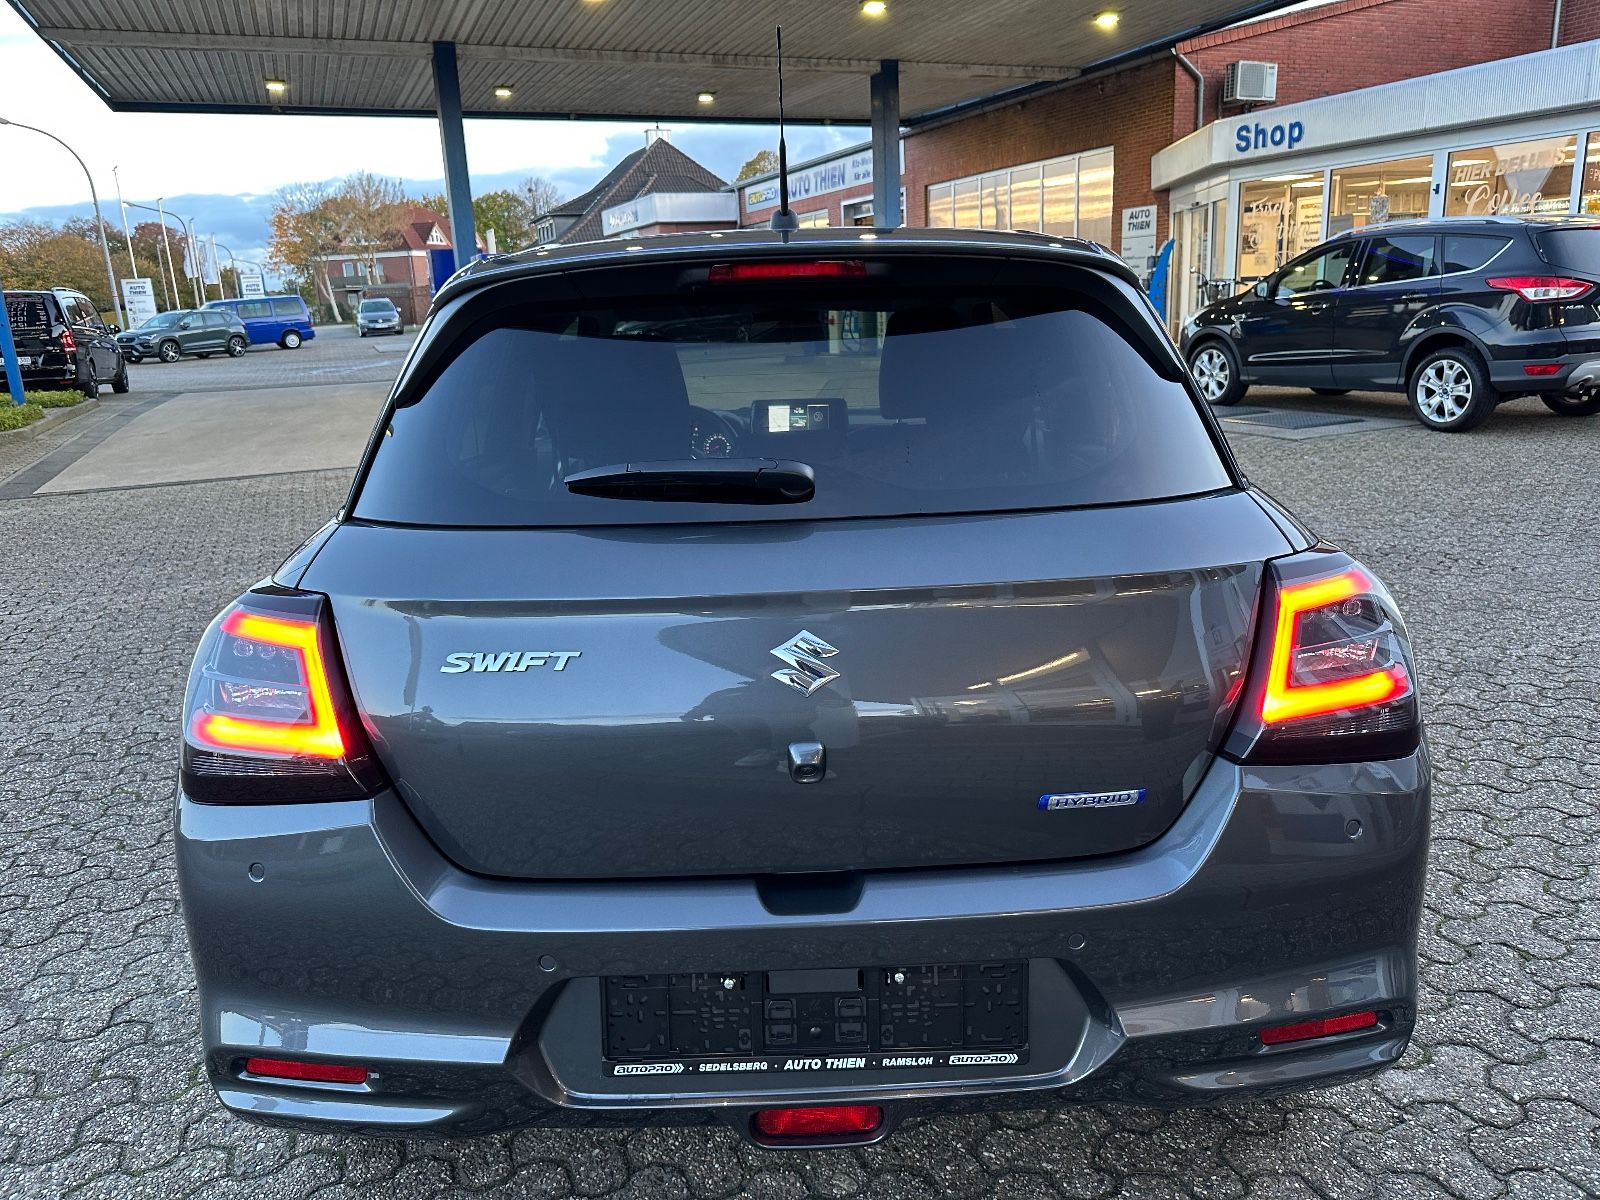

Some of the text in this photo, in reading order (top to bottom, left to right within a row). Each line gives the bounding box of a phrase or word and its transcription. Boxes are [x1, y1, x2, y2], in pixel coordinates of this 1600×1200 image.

[1235, 121, 1304, 152] Shop
[813, 163, 846, 192] THIEN
[1455, 162, 1491, 182] HIER
[1129, 209, 1150, 221] AUTO
[1128, 220, 1151, 231] THIEN
[440, 651, 583, 674] SWIFT
[1055, 793, 1132, 807] HYBRID
[698, 1062, 768, 1072] SEDELSBERG
[784, 1059, 821, 1070] AUTO
[826, 1057, 866, 1069] THIEN
[882, 1057, 934, 1066] RAMSLOH
